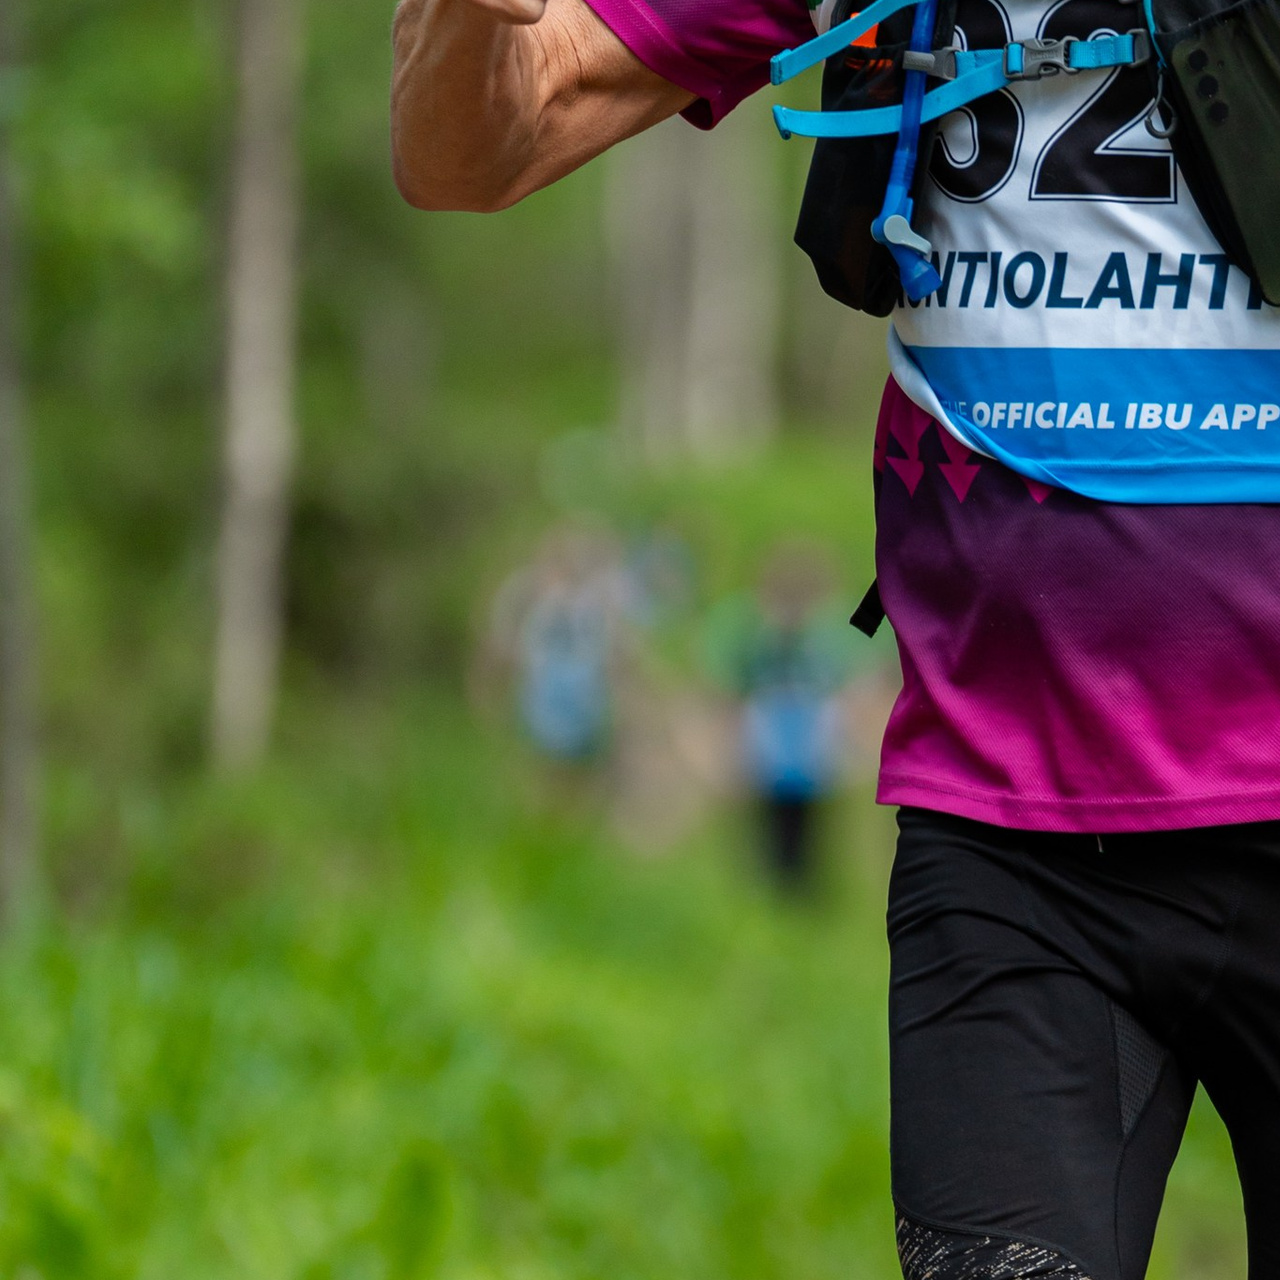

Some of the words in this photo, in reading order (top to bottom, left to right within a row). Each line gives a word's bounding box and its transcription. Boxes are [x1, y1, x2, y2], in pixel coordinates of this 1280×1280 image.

[897, 251, 1263, 310] NTIOLAHT
[973, 402, 1115, 429] OFFICIAL
[1125, 403, 1192, 430] IBU
[1200, 404, 1280, 430] APP
